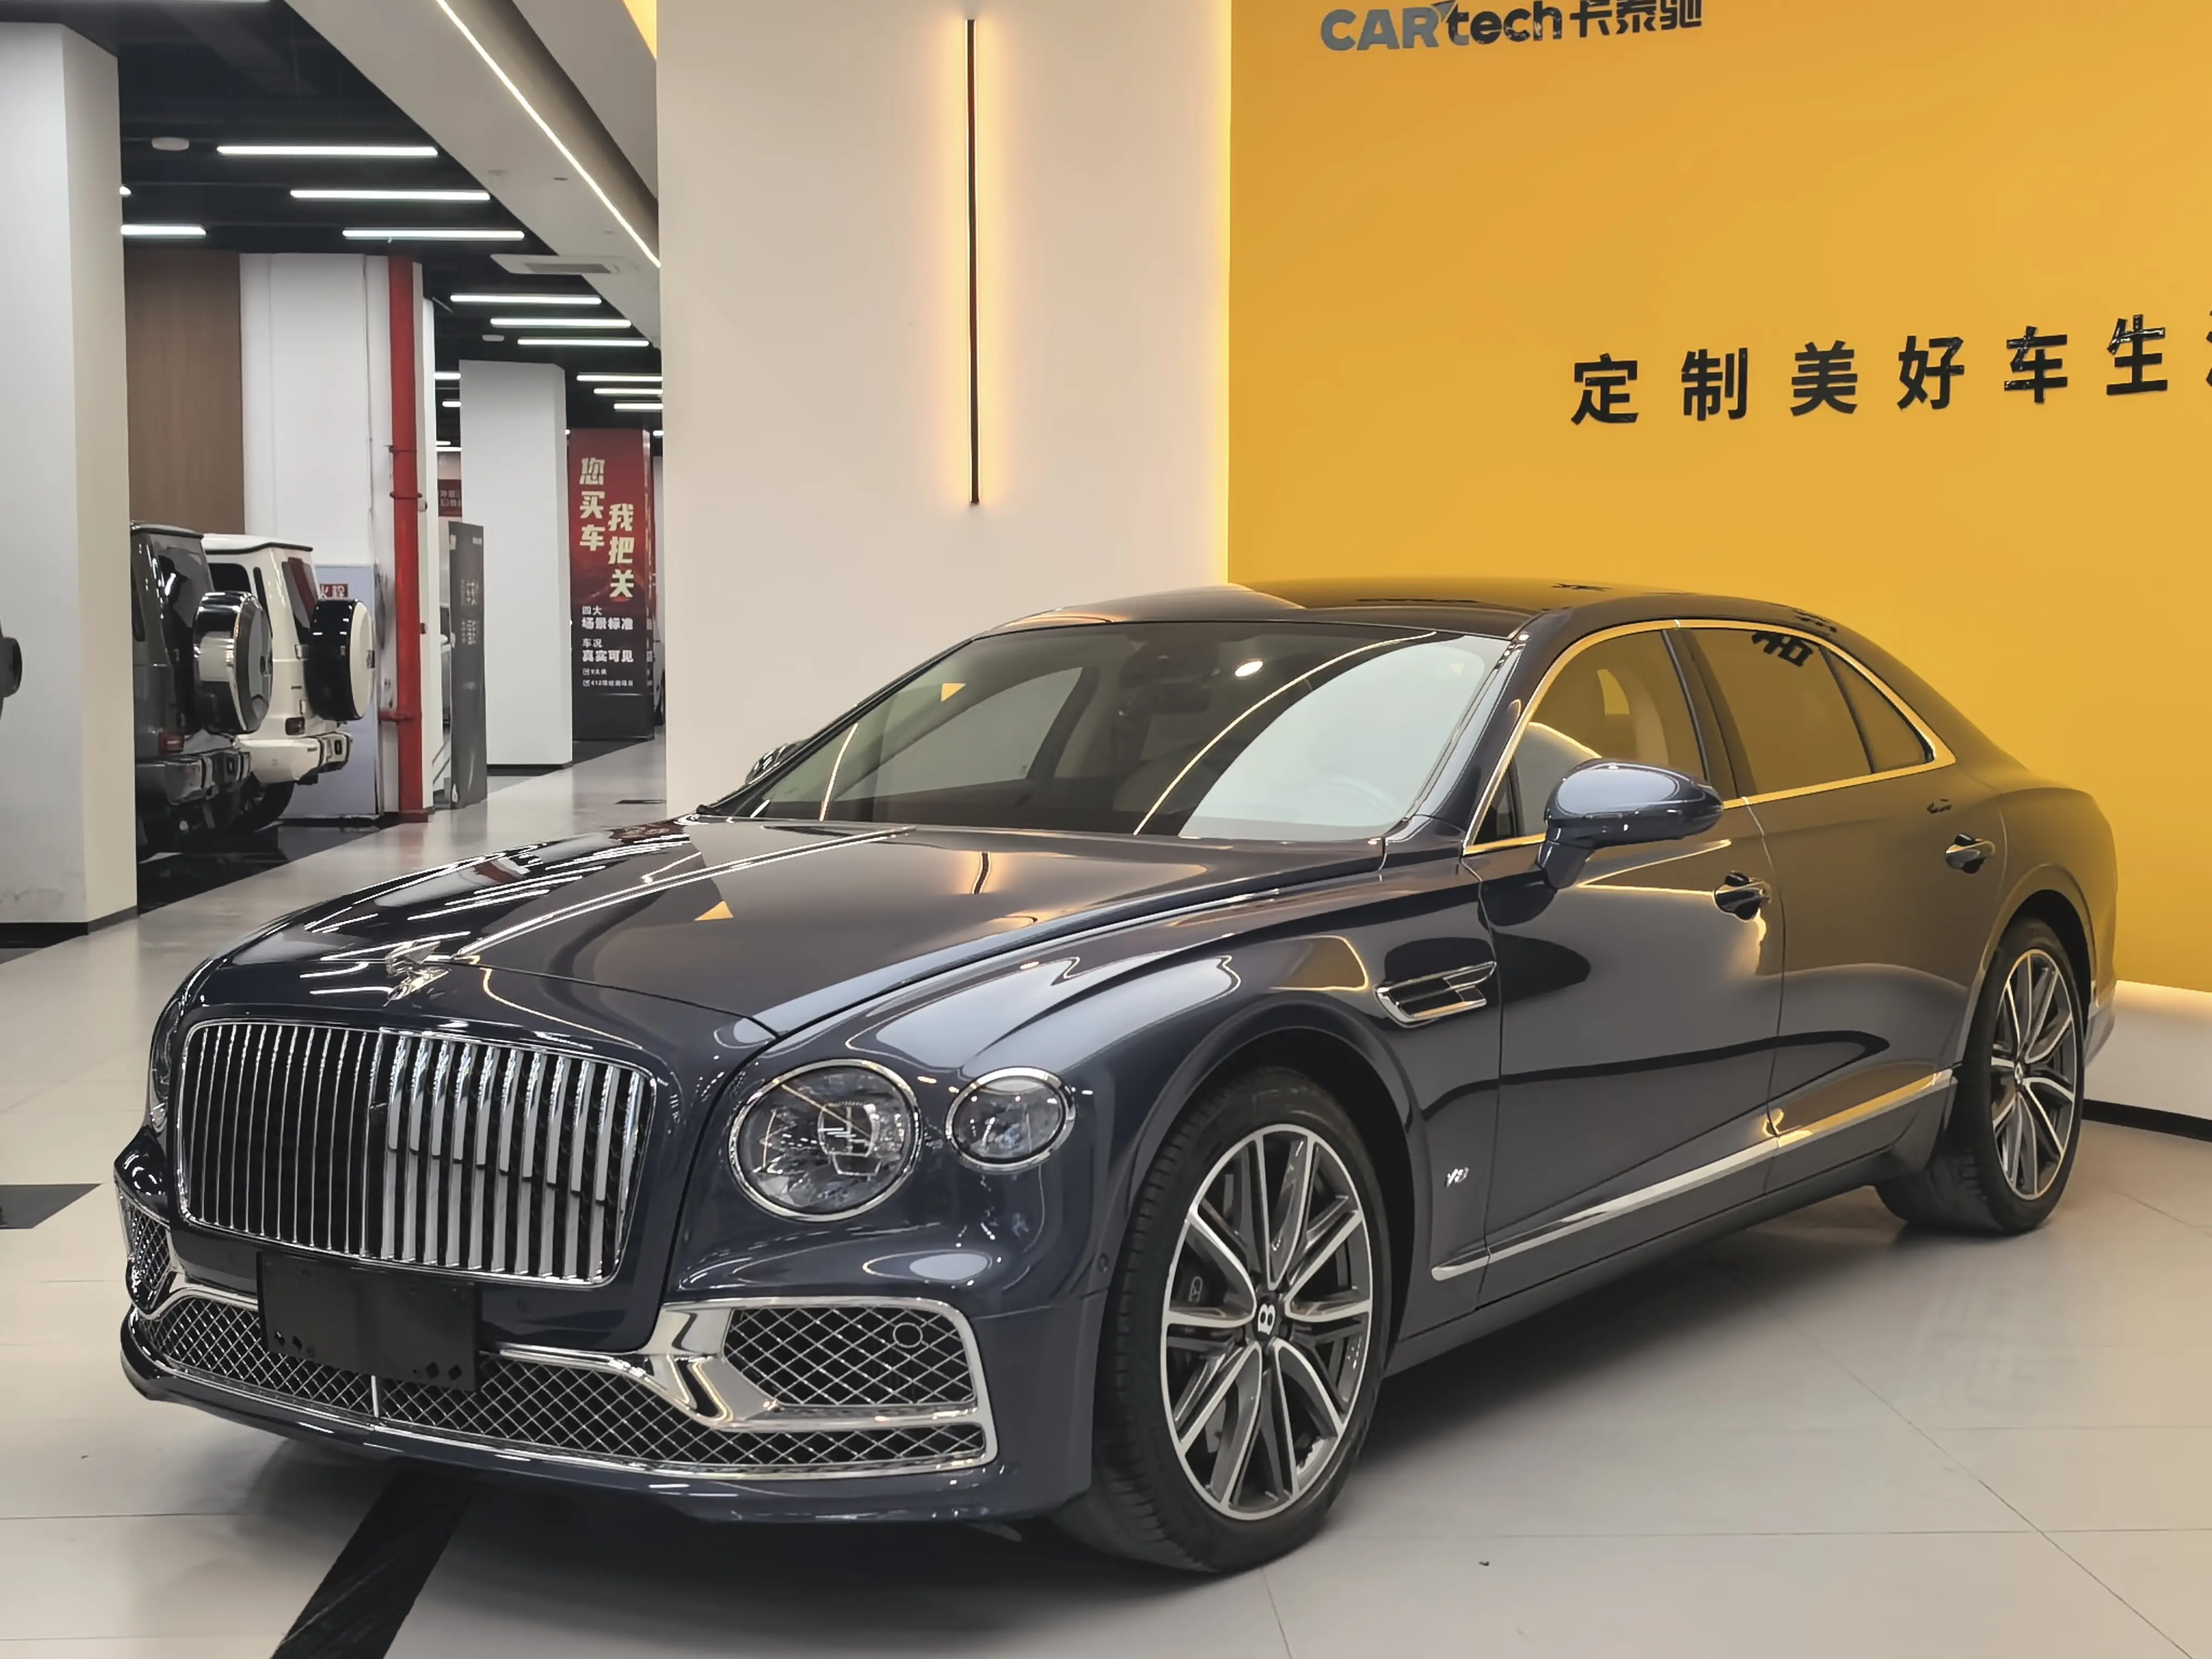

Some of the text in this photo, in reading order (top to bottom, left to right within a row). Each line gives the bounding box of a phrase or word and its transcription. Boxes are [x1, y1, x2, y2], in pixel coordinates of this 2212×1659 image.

[1320, 1, 1562, 51] CARtech
[1571, 310, 2212, 426] 定制美好车生
[579, 457, 605, 551] 您买车
[608, 503, 635, 598] 我把关
[582, 617, 633, 630] 场景标准
[582, 638, 603, 648] 车况
[582, 650, 634, 663] 真实可见
